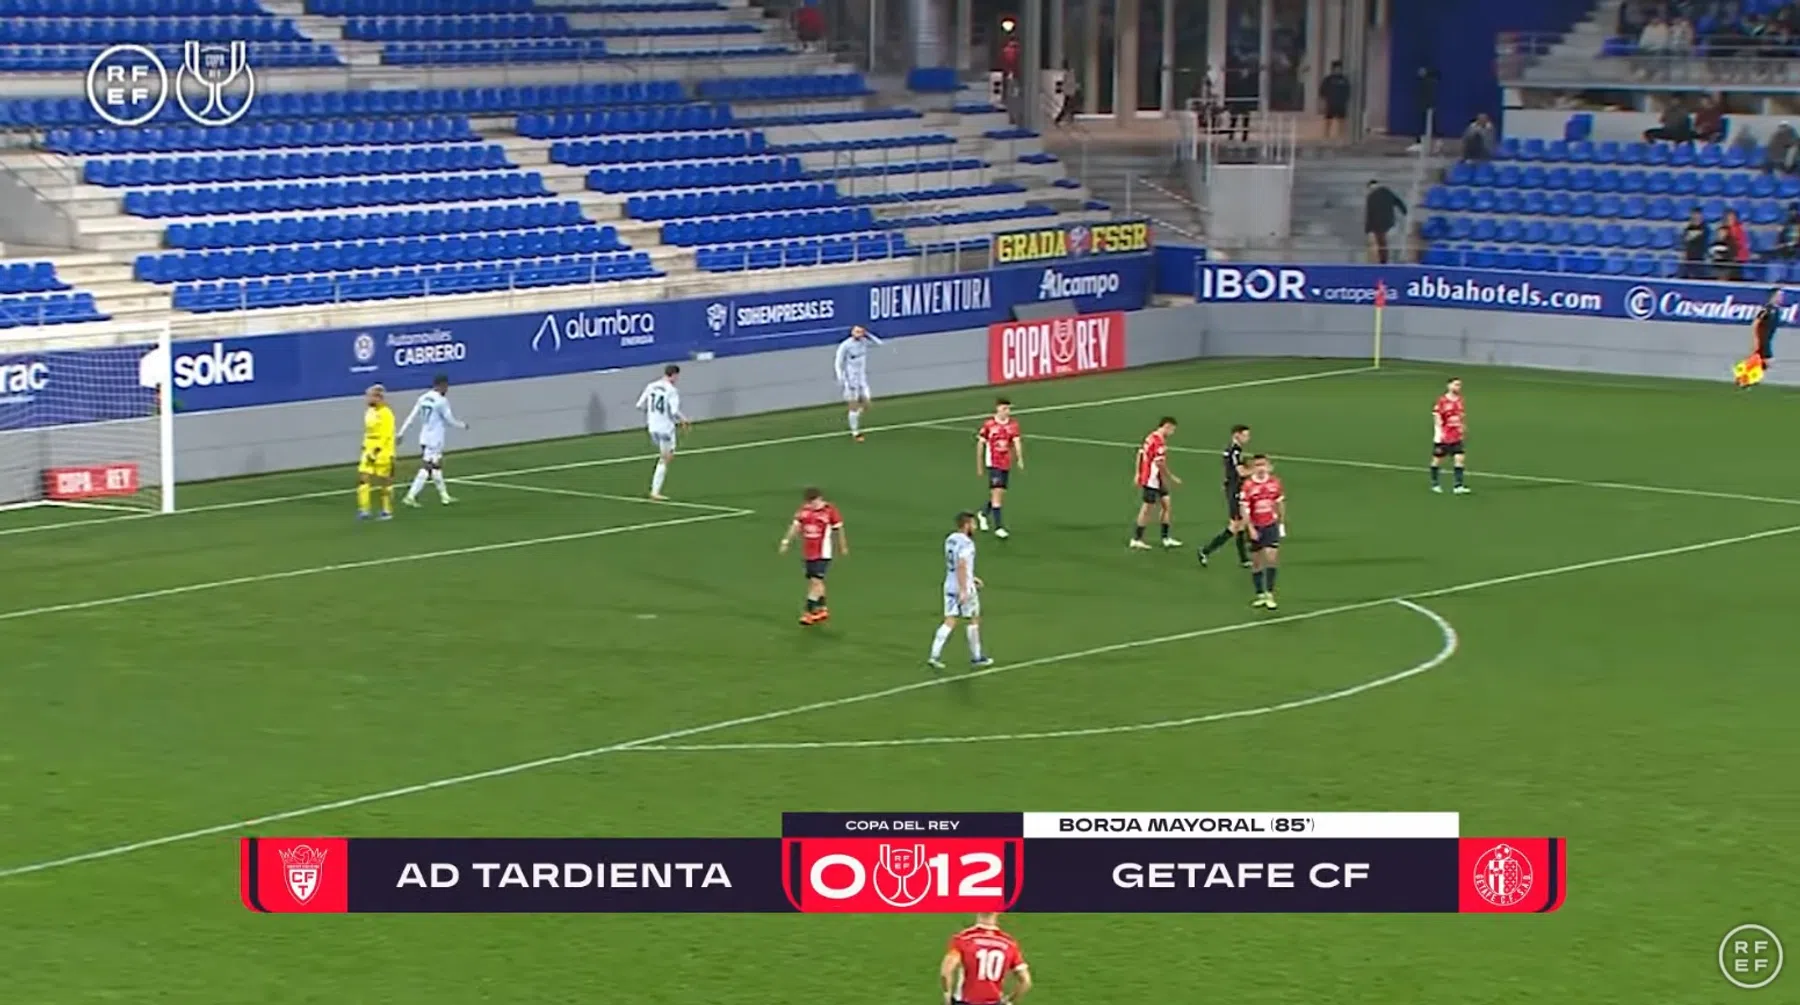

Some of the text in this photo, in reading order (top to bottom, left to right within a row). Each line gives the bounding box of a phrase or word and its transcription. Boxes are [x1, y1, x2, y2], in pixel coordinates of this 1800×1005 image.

[998, 222, 1148, 262] GRADA FSSR
[869, 277, 992, 320] BUENAVENTURA
[1039, 269, 1119, 299] Alcampo
[1203, 268, 1306, 299] IBOR
[1406, 277, 1602, 310] abbahotels.com
[565, 308, 655, 339] alumbra
[173, 342, 254, 388] soka
[394, 342, 466, 366] CABRERO
[1002, 317, 1110, 380] COPA REY
[650, 393, 665, 414] 14
[975, 948, 1005, 982] 10
